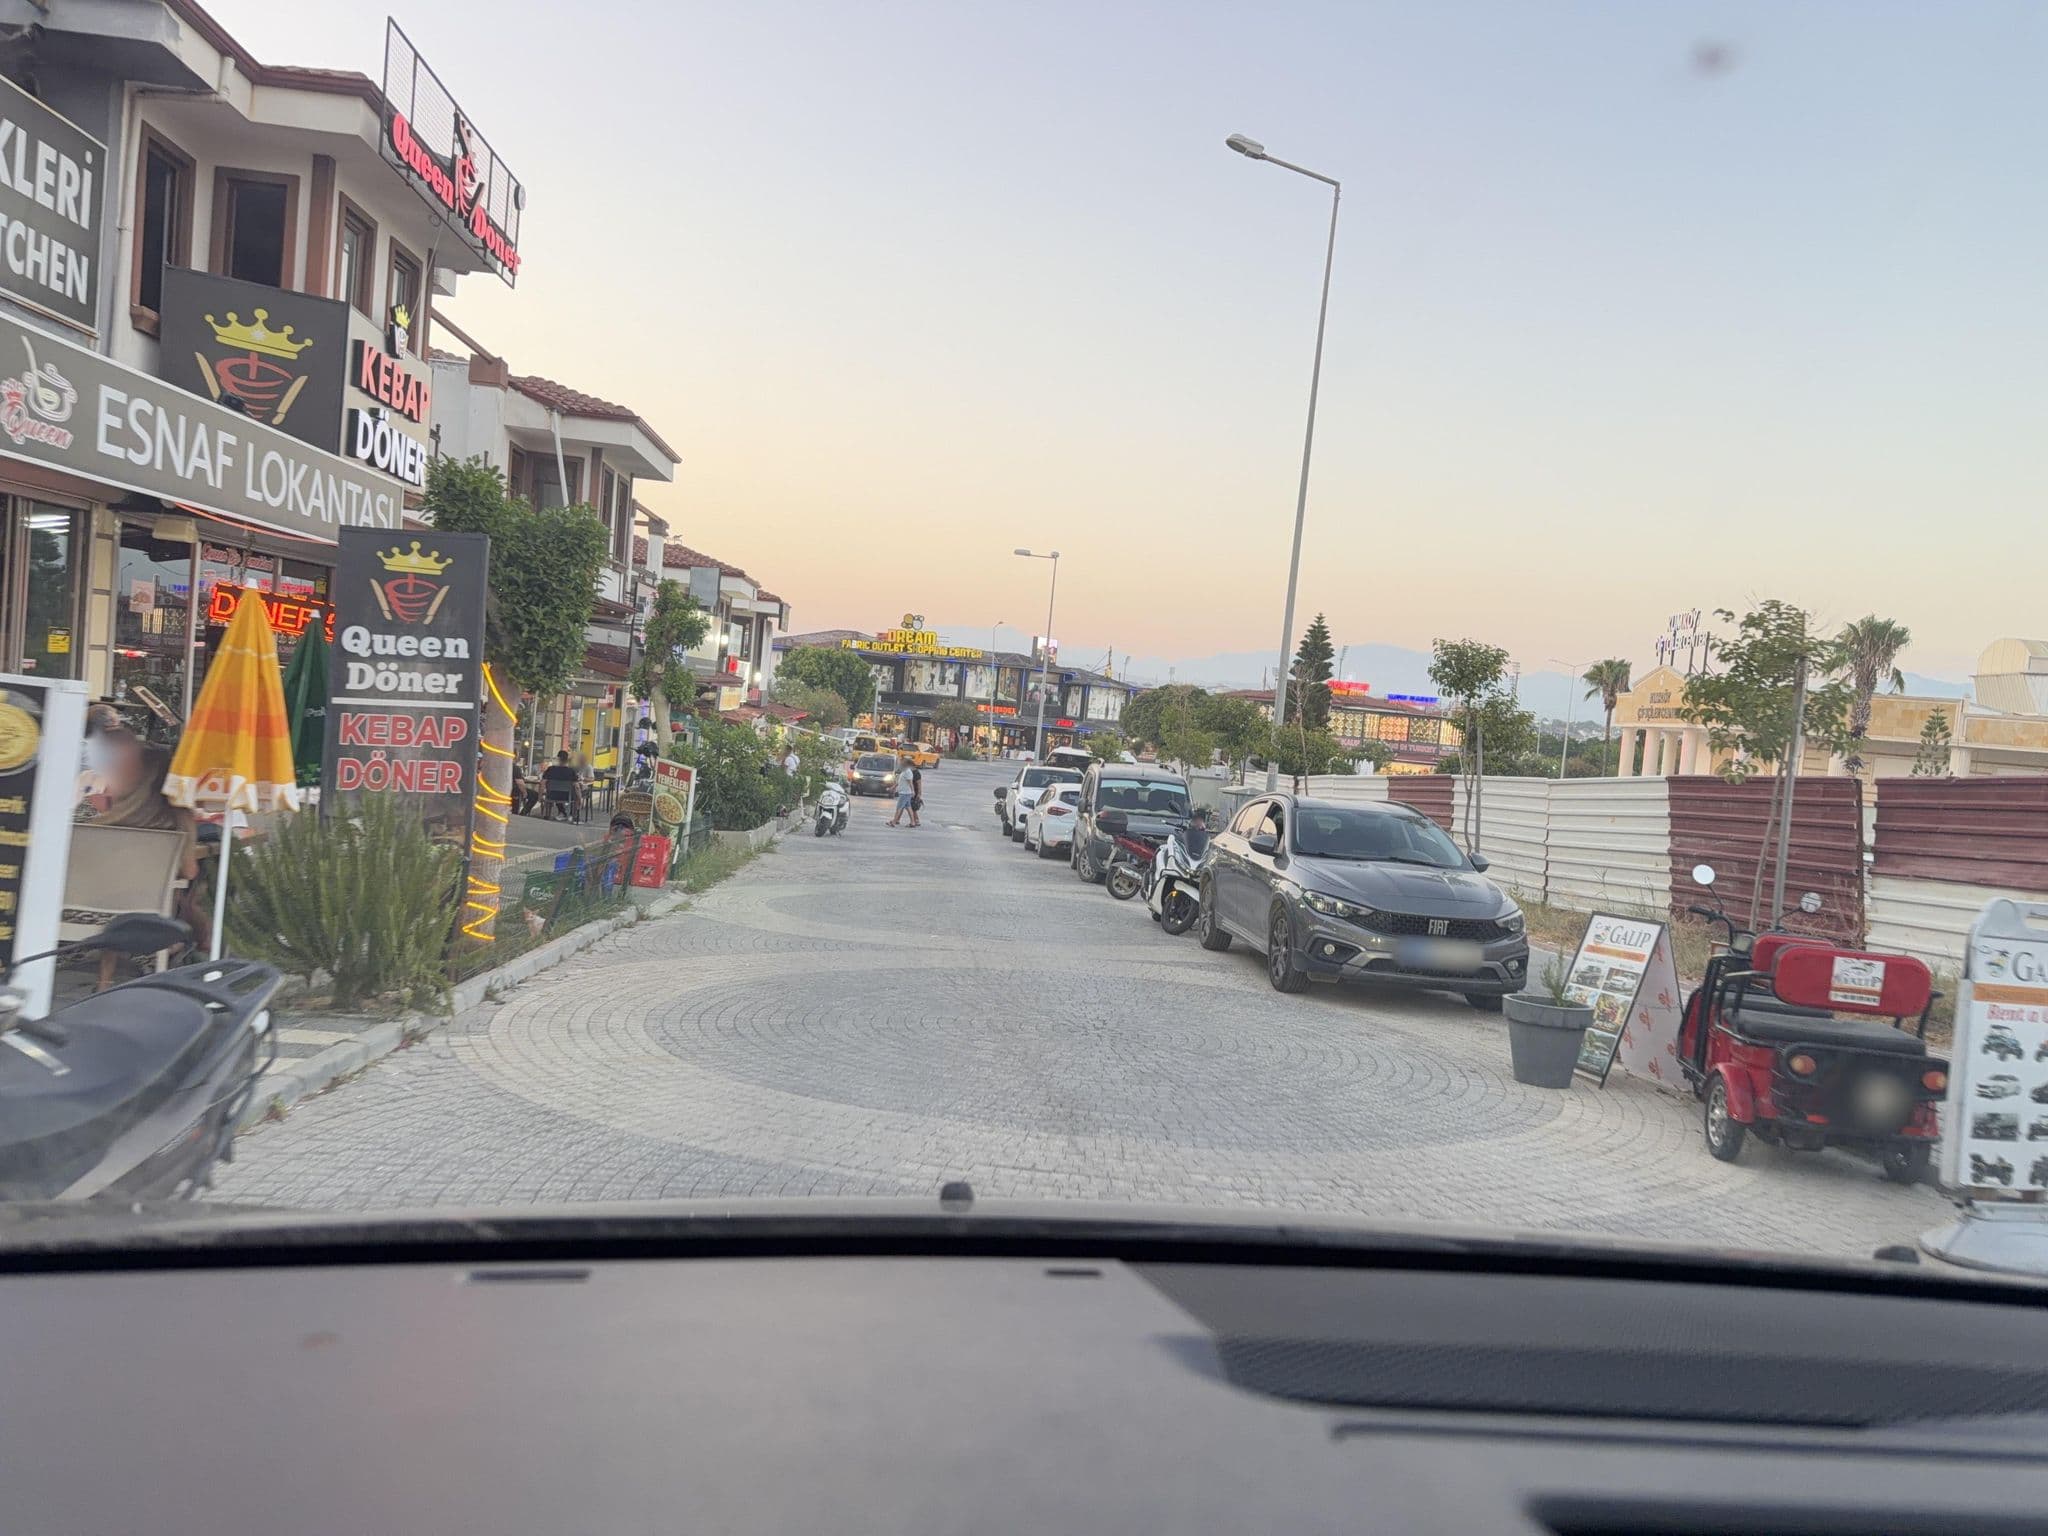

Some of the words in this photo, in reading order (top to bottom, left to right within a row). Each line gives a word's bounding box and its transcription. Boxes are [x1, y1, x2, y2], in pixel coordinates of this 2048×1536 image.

[392, 112, 455, 209] Queen
[360, 340, 432, 423] KEBAP
[97, 384, 237, 490] ESNAF
[245, 442, 396, 530] LOKANTASI
[355, 407, 427, 488] DÖNER
[212, 590, 313, 629] DNER
[341, 625, 470, 659] Queen
[841, 639, 870, 650] FABRIC
[872, 641, 905, 652] OUTLET
[949, 647, 983, 659] CENTER
[887, 629, 938, 645] DREAM
[345, 662, 463, 694] Döner
[338, 713, 468, 749] KEBAP
[336, 750, 462, 794] DÖNER
[1428, 919, 1450, 936] FIAT
[1609, 925, 1651, 948] GALİP
